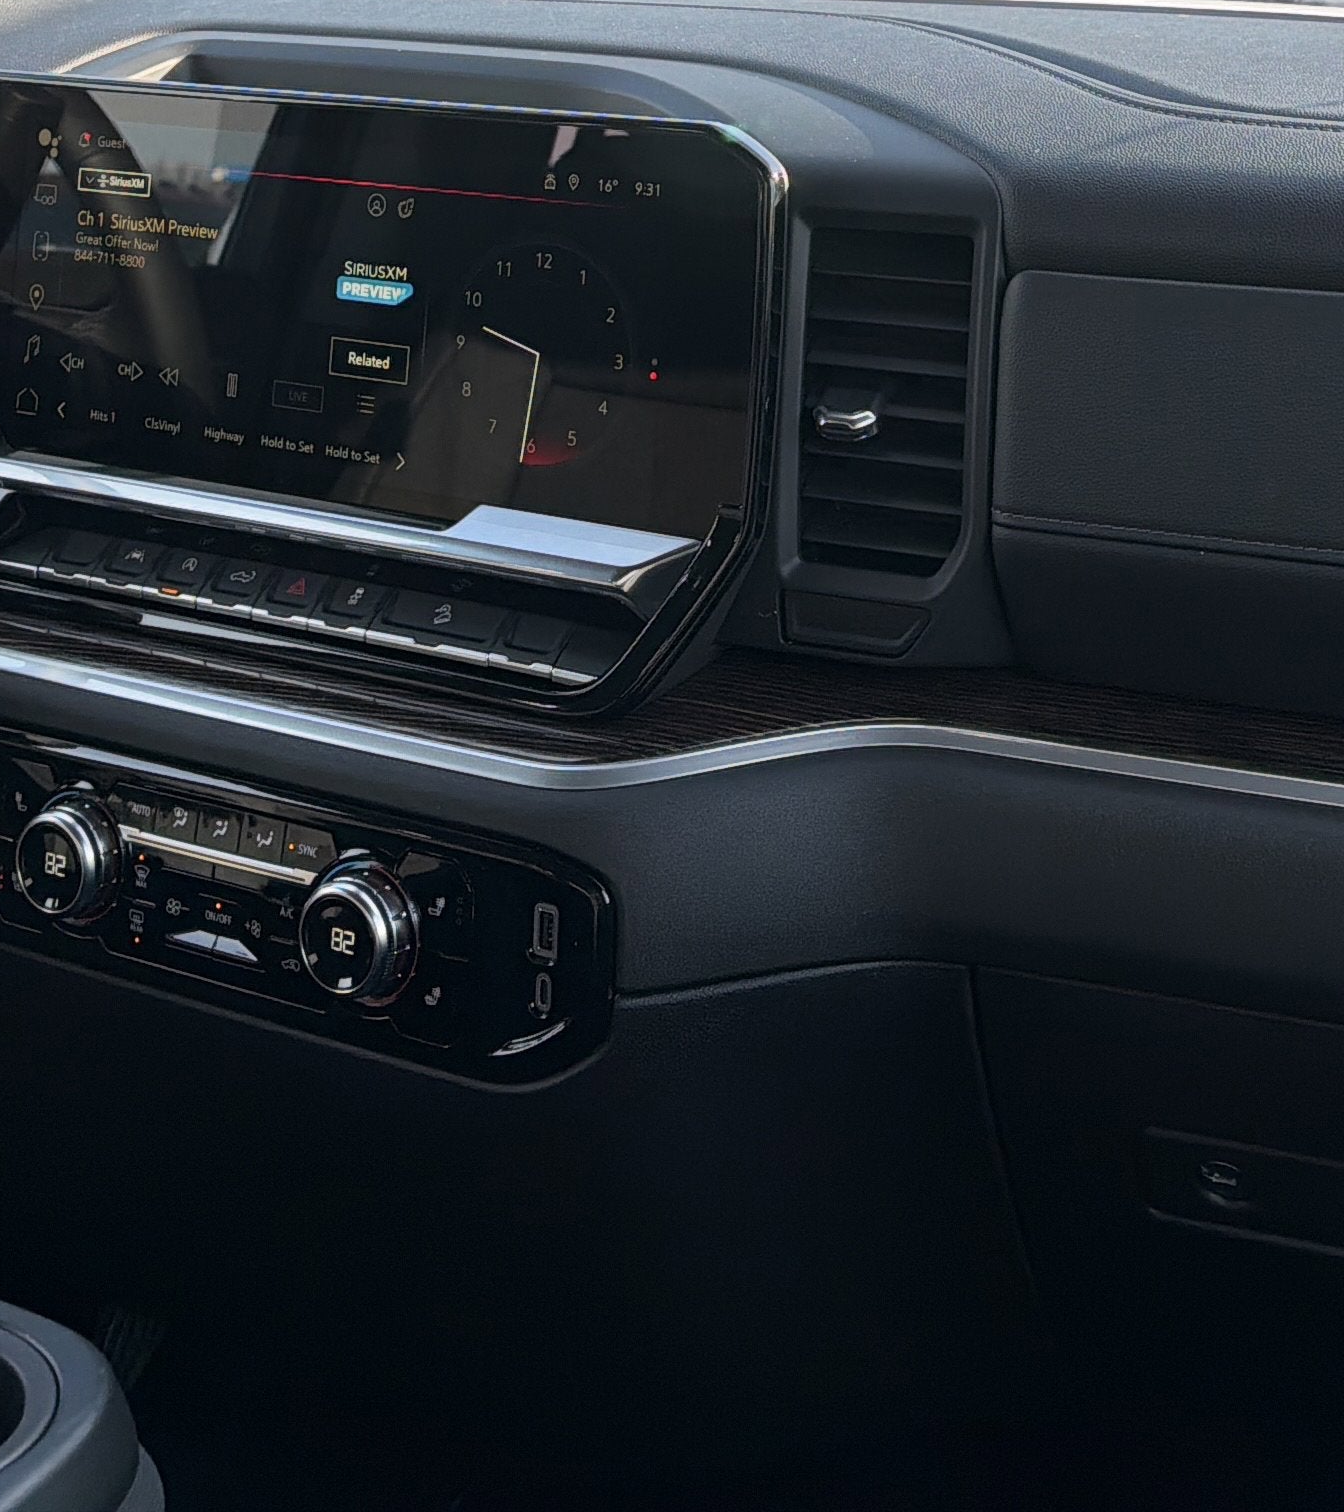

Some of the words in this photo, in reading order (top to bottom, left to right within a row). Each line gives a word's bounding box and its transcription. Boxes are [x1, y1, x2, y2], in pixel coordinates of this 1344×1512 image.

[97, 136, 127, 149] Guest
[109, 176, 145, 189] SiriusXM
[597, 178, 619, 194] 16°
[634, 181, 661, 198] 9:31
[77, 210, 94, 226] Ch
[98, 212, 103, 227] 1
[110, 214, 165, 234] SiriusXM
[168, 220, 219, 240] Preview
[75, 232, 103, 245] Great
[105, 235, 131, 249] Offer
[134, 240, 159, 252] Now!
[74, 249, 145, 268] 844-711-8800
[536, 252, 553, 270] 12
[344, 261, 407, 281] SIRIUSXM
[496, 260, 512, 278] 11
[579, 270, 587, 286] 1
[342, 282, 407, 300] PREVIEW
[464, 290, 482, 308] 10
[606, 308, 616, 324] 2
[456, 335, 466, 350] 9
[71, 357, 84, 370] CH
[348, 351, 391, 370] Related
[614, 354, 624, 370] 3
[118, 364, 132, 376] CH
[461, 381, 472, 397] 8
[90, 409, 108, 422] Hits
[111, 412, 116, 423] 1
[598, 400, 608, 416] 4
[488, 419, 497, 434] 7
[204, 426, 245, 446] Highway
[567, 430, 577, 447] 5
[260, 435, 284, 449] Hold
[286, 440, 296, 451] to
[298, 441, 314, 454] Set
[526, 438, 536, 454] 6
[325, 445, 349, 460] Hold
[351, 450, 361, 461] to
[363, 453, 381, 465] Set
[131, 804, 151, 817] AUTO
[298, 844, 318, 858] SYNC
[45, 851, 66, 878] 82
[205, 910, 233, 926] ON/OFF
[330, 927, 355, 956] 82
